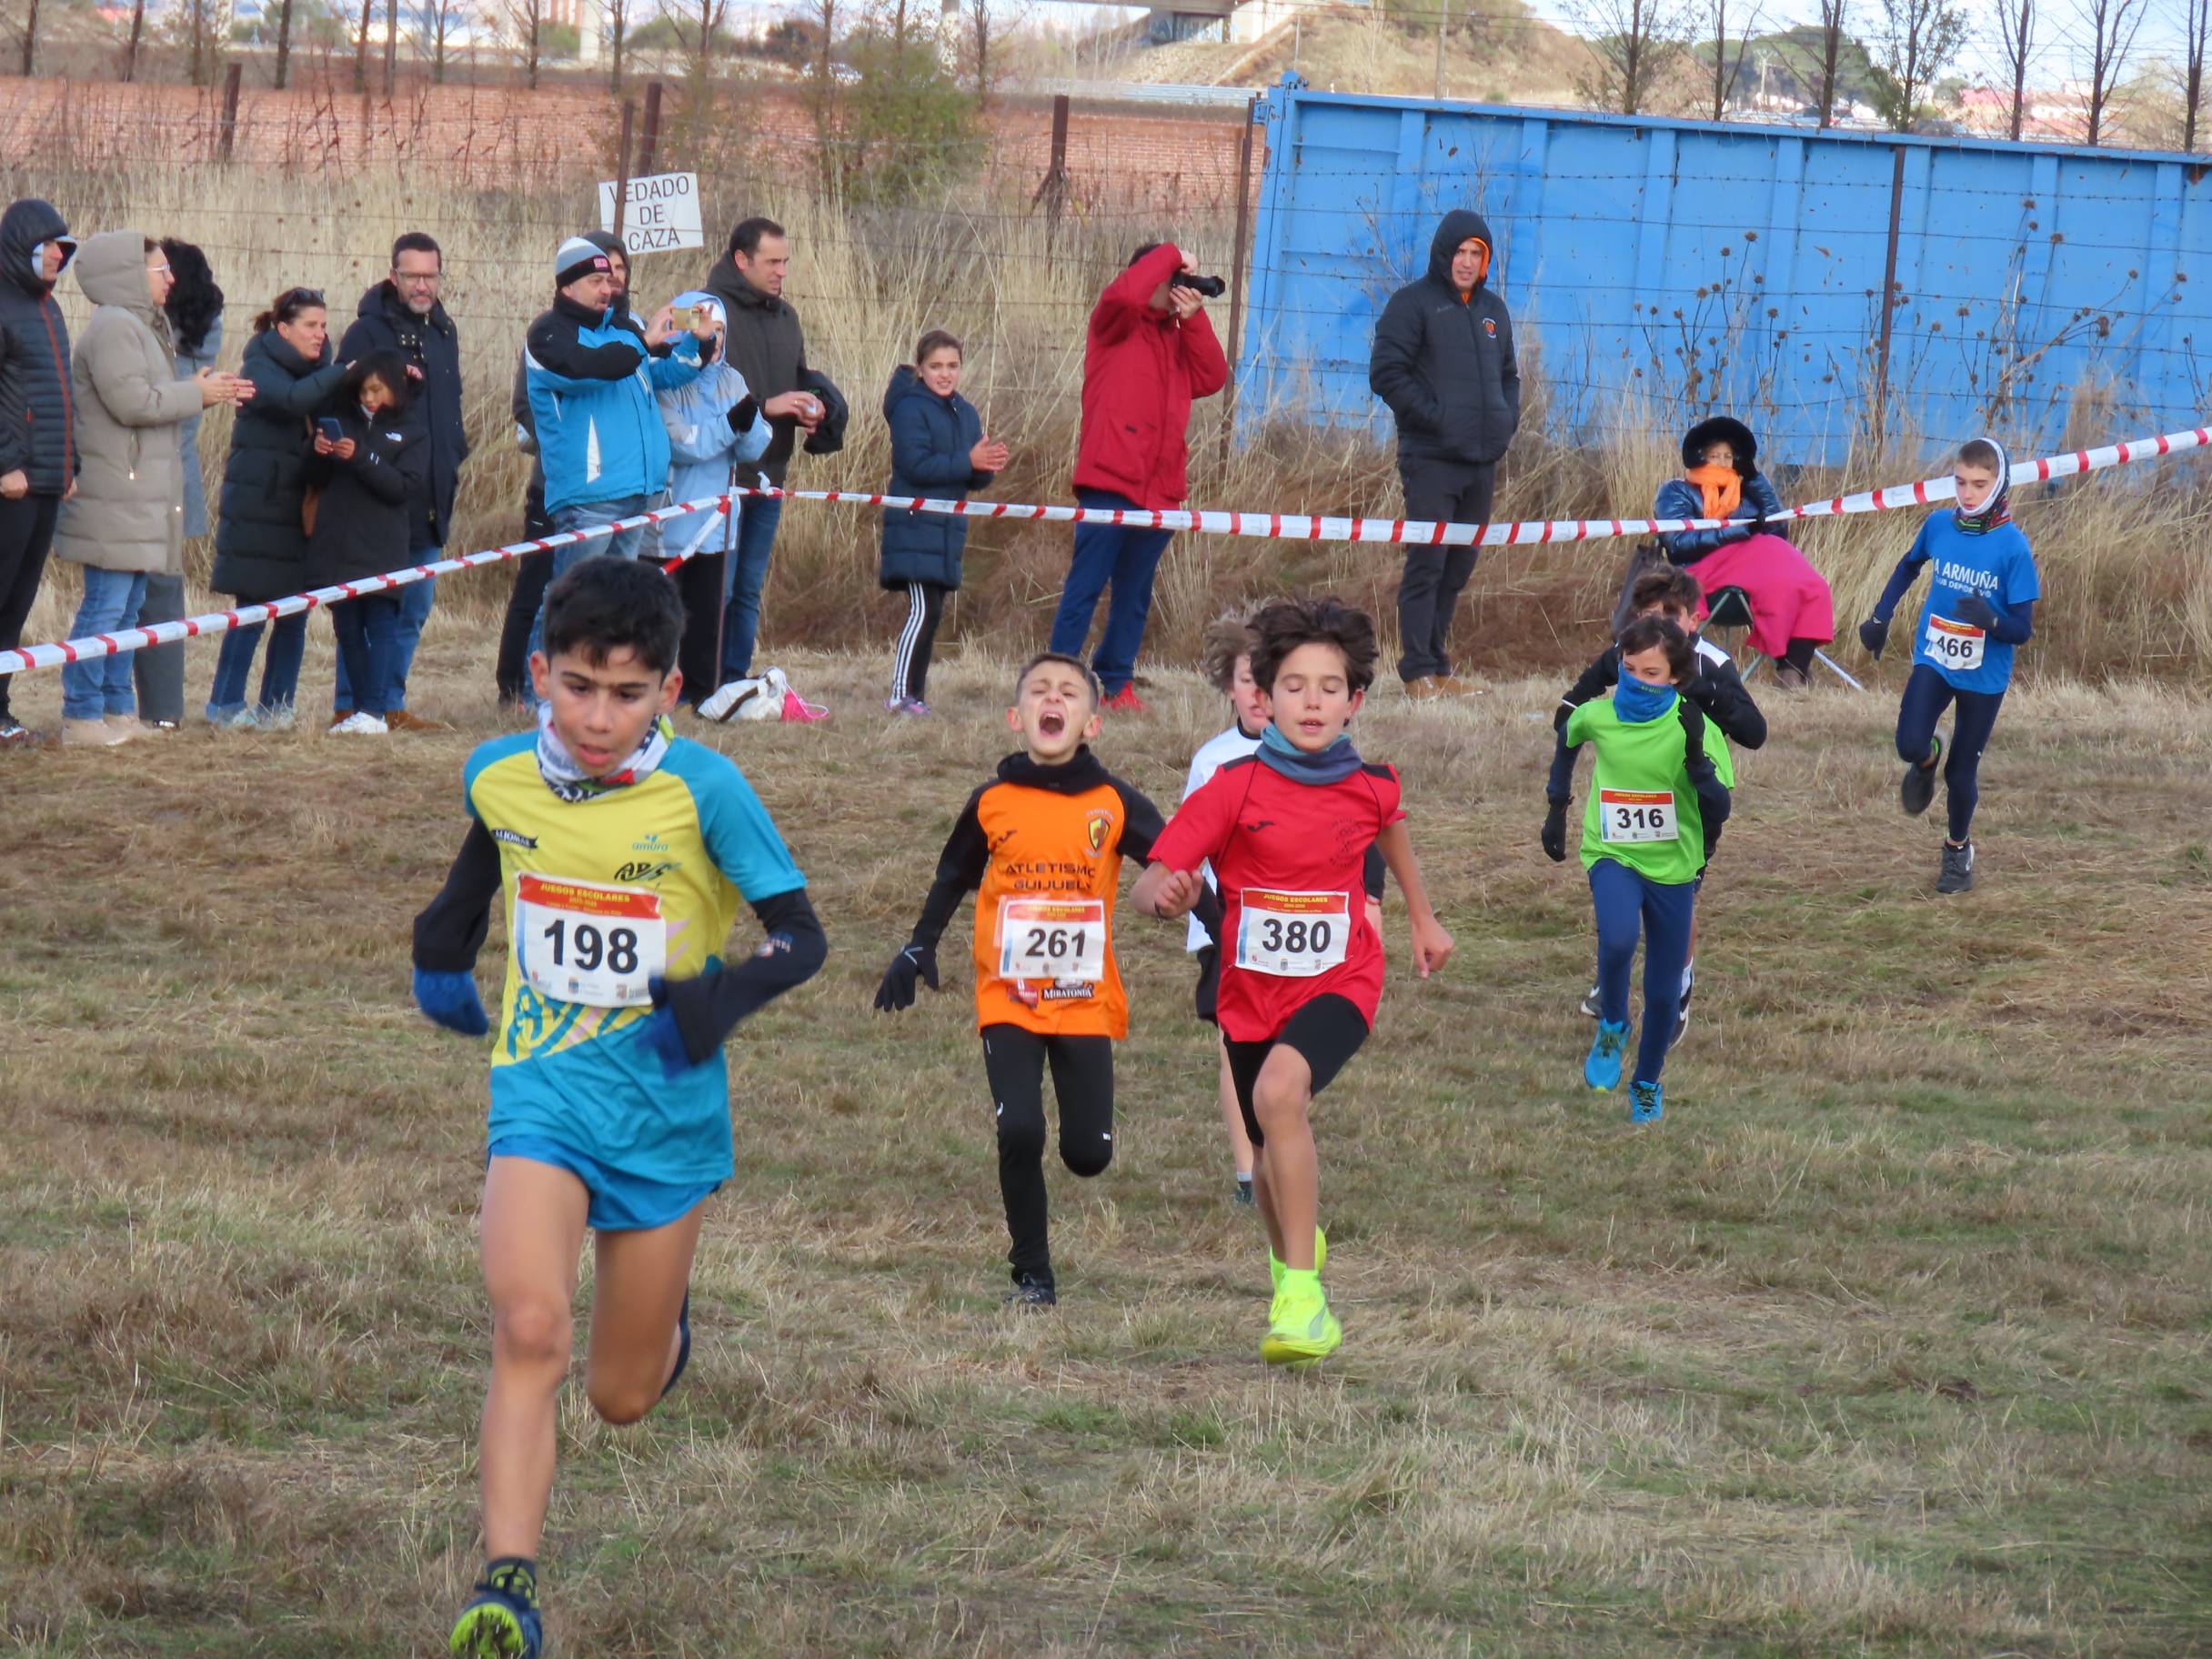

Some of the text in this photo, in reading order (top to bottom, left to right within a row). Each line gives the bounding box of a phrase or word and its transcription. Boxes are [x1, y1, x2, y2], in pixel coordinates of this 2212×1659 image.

[608, 176, 689, 204] VEDADO
[639, 204, 664, 226] DE
[628, 227, 680, 252] CAZA
[1942, 561, 1998, 590] ARMUÑA
[1948, 580, 1992, 598] DEPORVO
[1937, 636, 1973, 659] 466
[1616, 808, 1664, 829] 316
[539, 882, 575, 896] JUEGOS
[577, 888, 630, 903] ESCOLARES
[544, 920, 638, 974] 198
[1025, 928, 1086, 958] 261
[1262, 918, 1332, 954] 380
